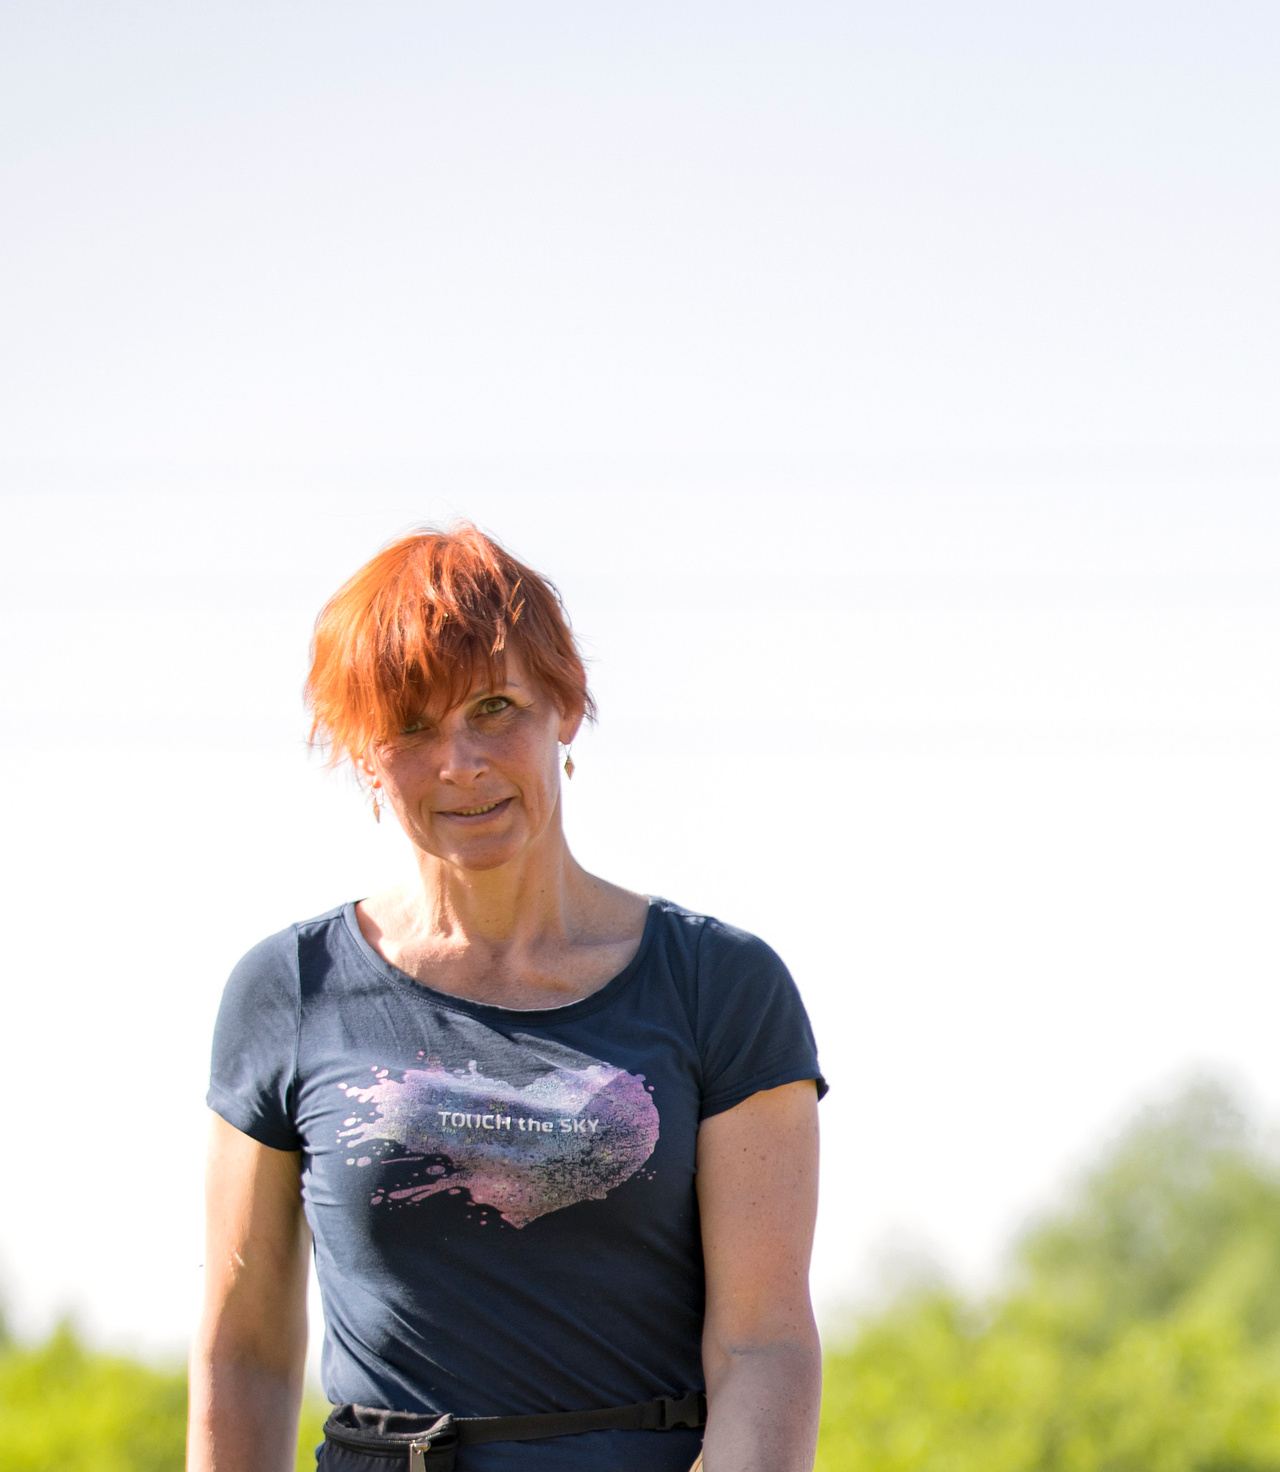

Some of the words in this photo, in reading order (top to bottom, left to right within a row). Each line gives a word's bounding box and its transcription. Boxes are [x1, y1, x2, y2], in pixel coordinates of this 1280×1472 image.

[438, 1111, 511, 1131] TOUCH
[518, 1118, 553, 1132] the
[560, 1118, 600, 1133] SKY
